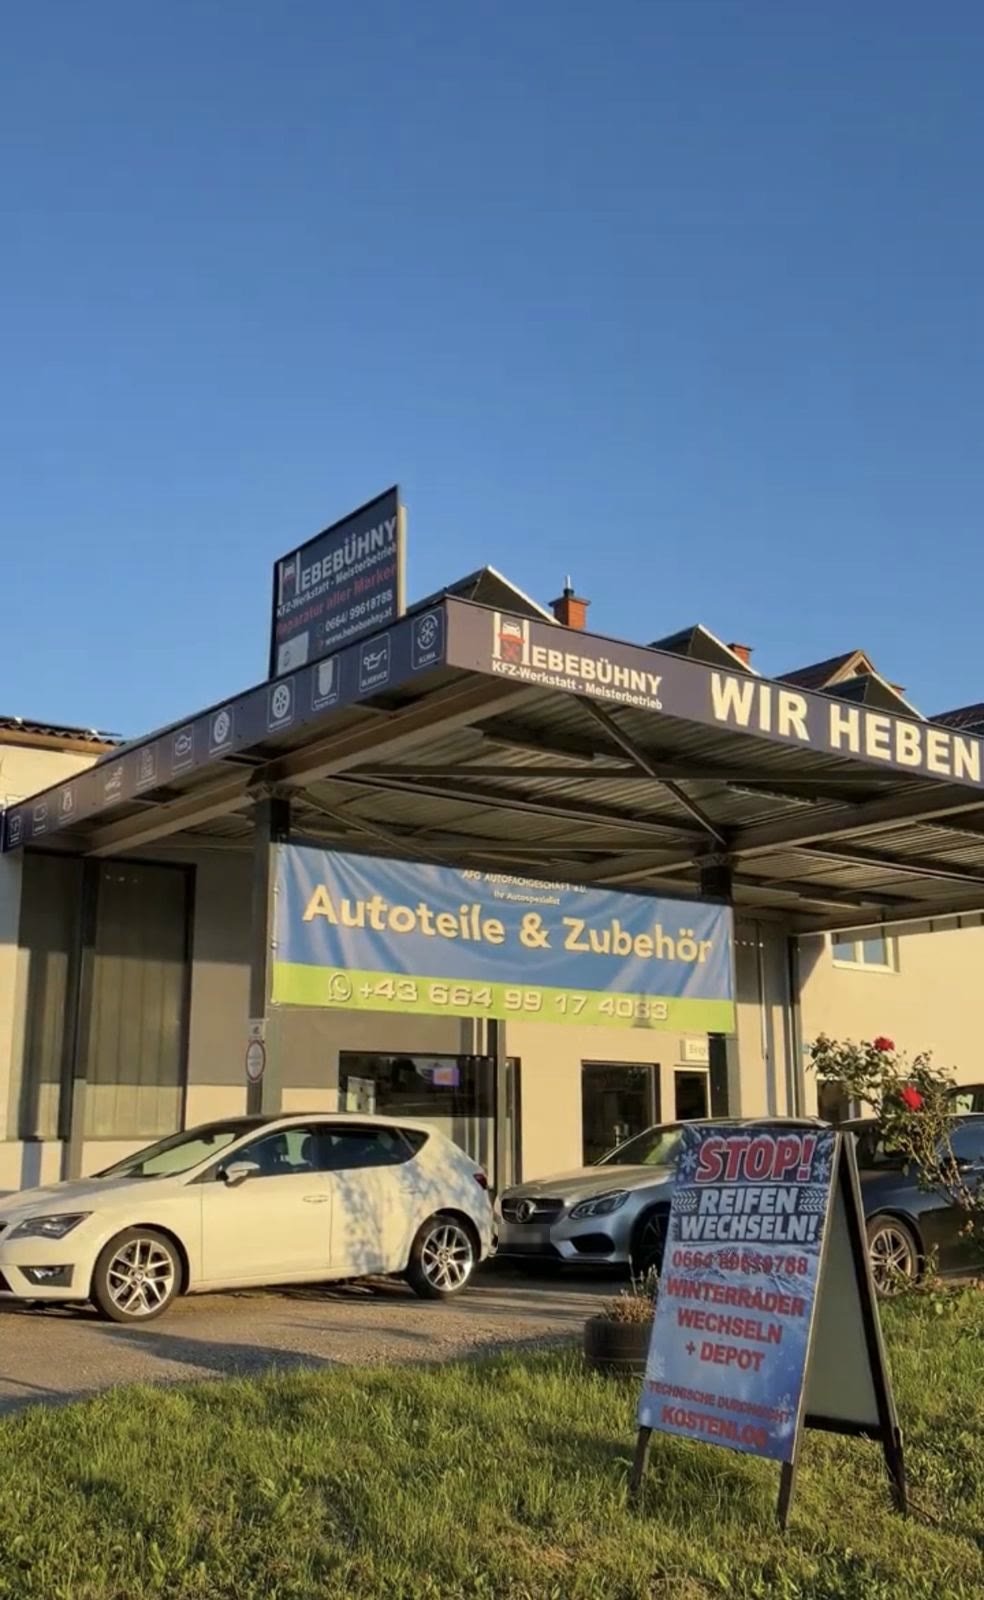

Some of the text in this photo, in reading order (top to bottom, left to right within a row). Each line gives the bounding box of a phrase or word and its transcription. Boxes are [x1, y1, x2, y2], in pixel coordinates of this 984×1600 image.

[492, 660, 577, 690] KFZ-Werkstatt
[585, 682, 663, 711] Meisterbetrieb
[711, 672, 981, 783] WIR HEBEN
[302, 884, 713, 963] Autoteile & Zubehör
[359, 978, 417, 1002] +43
[428, 983, 493, 1009] 664
[505, 990, 543, 1011] 99
[555, 994, 588, 1014] 17
[695, 1134, 818, 1182] STOP!
[699, 1187, 799, 1214] REIFEN
[681, 1214, 819, 1241] WECHSELN!
[667, 1275, 805, 1317] WINTERRÄDER
[678, 1306, 783, 1345] WECHSELN
[700, 1341, 765, 1372] DEPOT
[649, 1380, 716, 1407] TECHNISCHE
